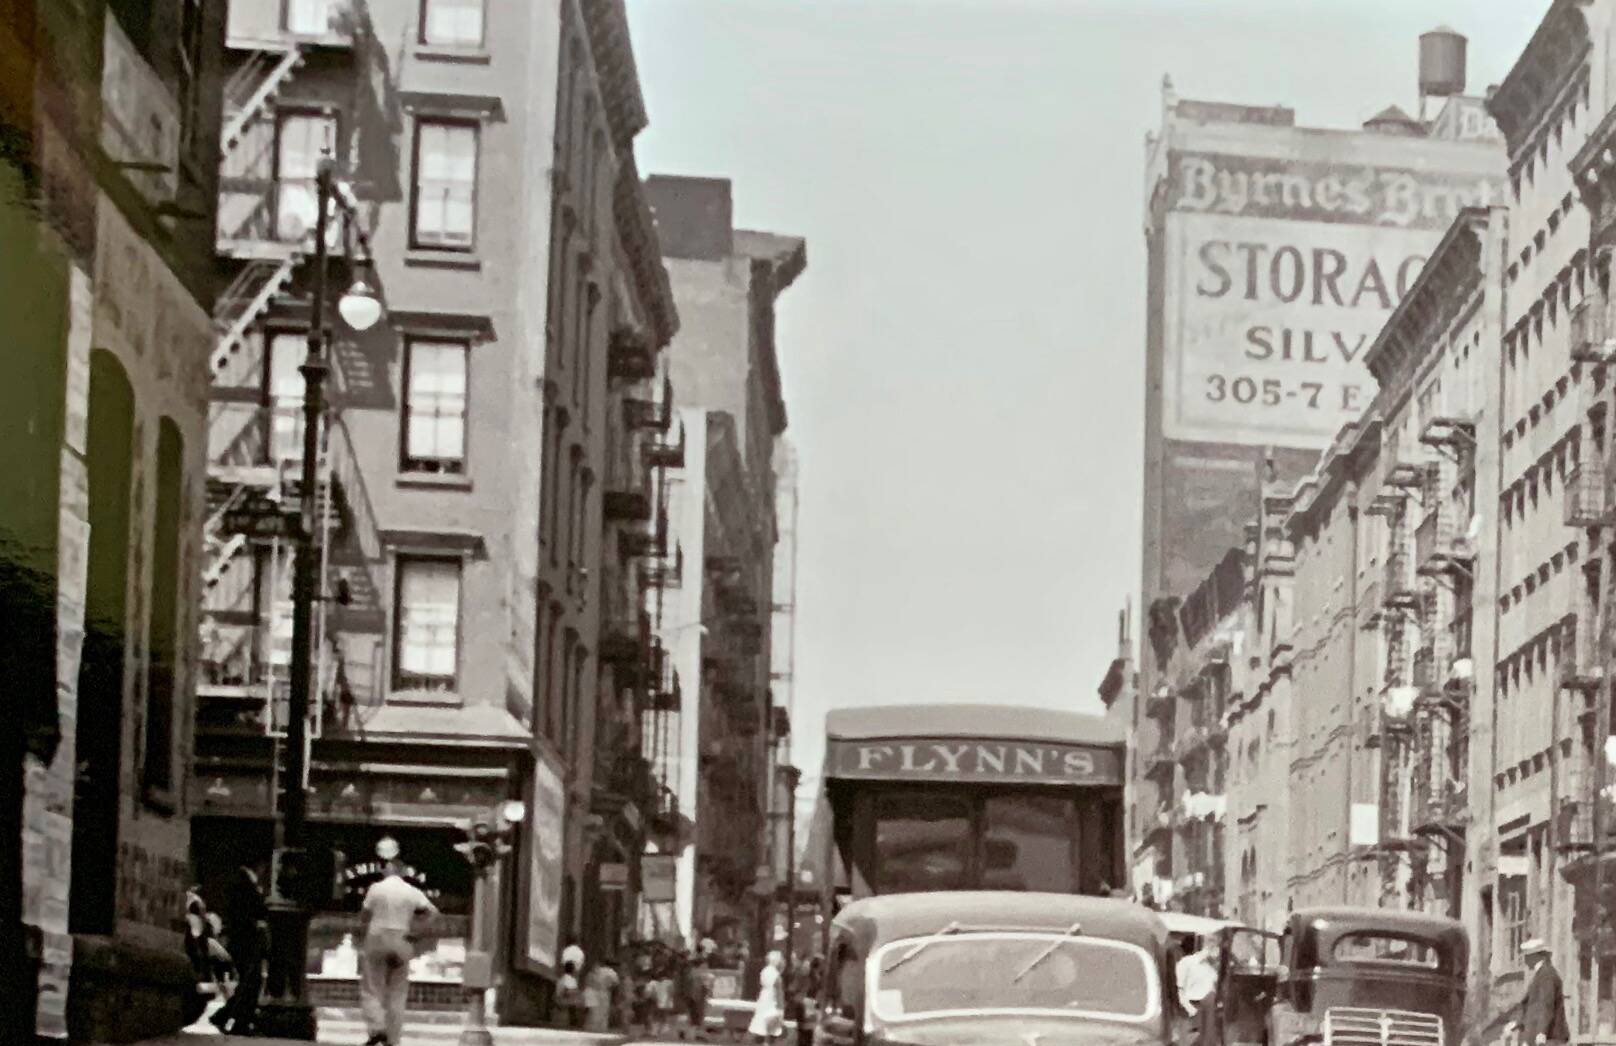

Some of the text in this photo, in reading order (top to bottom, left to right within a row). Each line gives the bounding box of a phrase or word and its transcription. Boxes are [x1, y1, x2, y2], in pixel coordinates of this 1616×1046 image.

[1244, 325, 1367, 363] SILV
[1205, 373, 1324, 410] 305-7
[857, 744, 1094, 775] FLYNN'S
